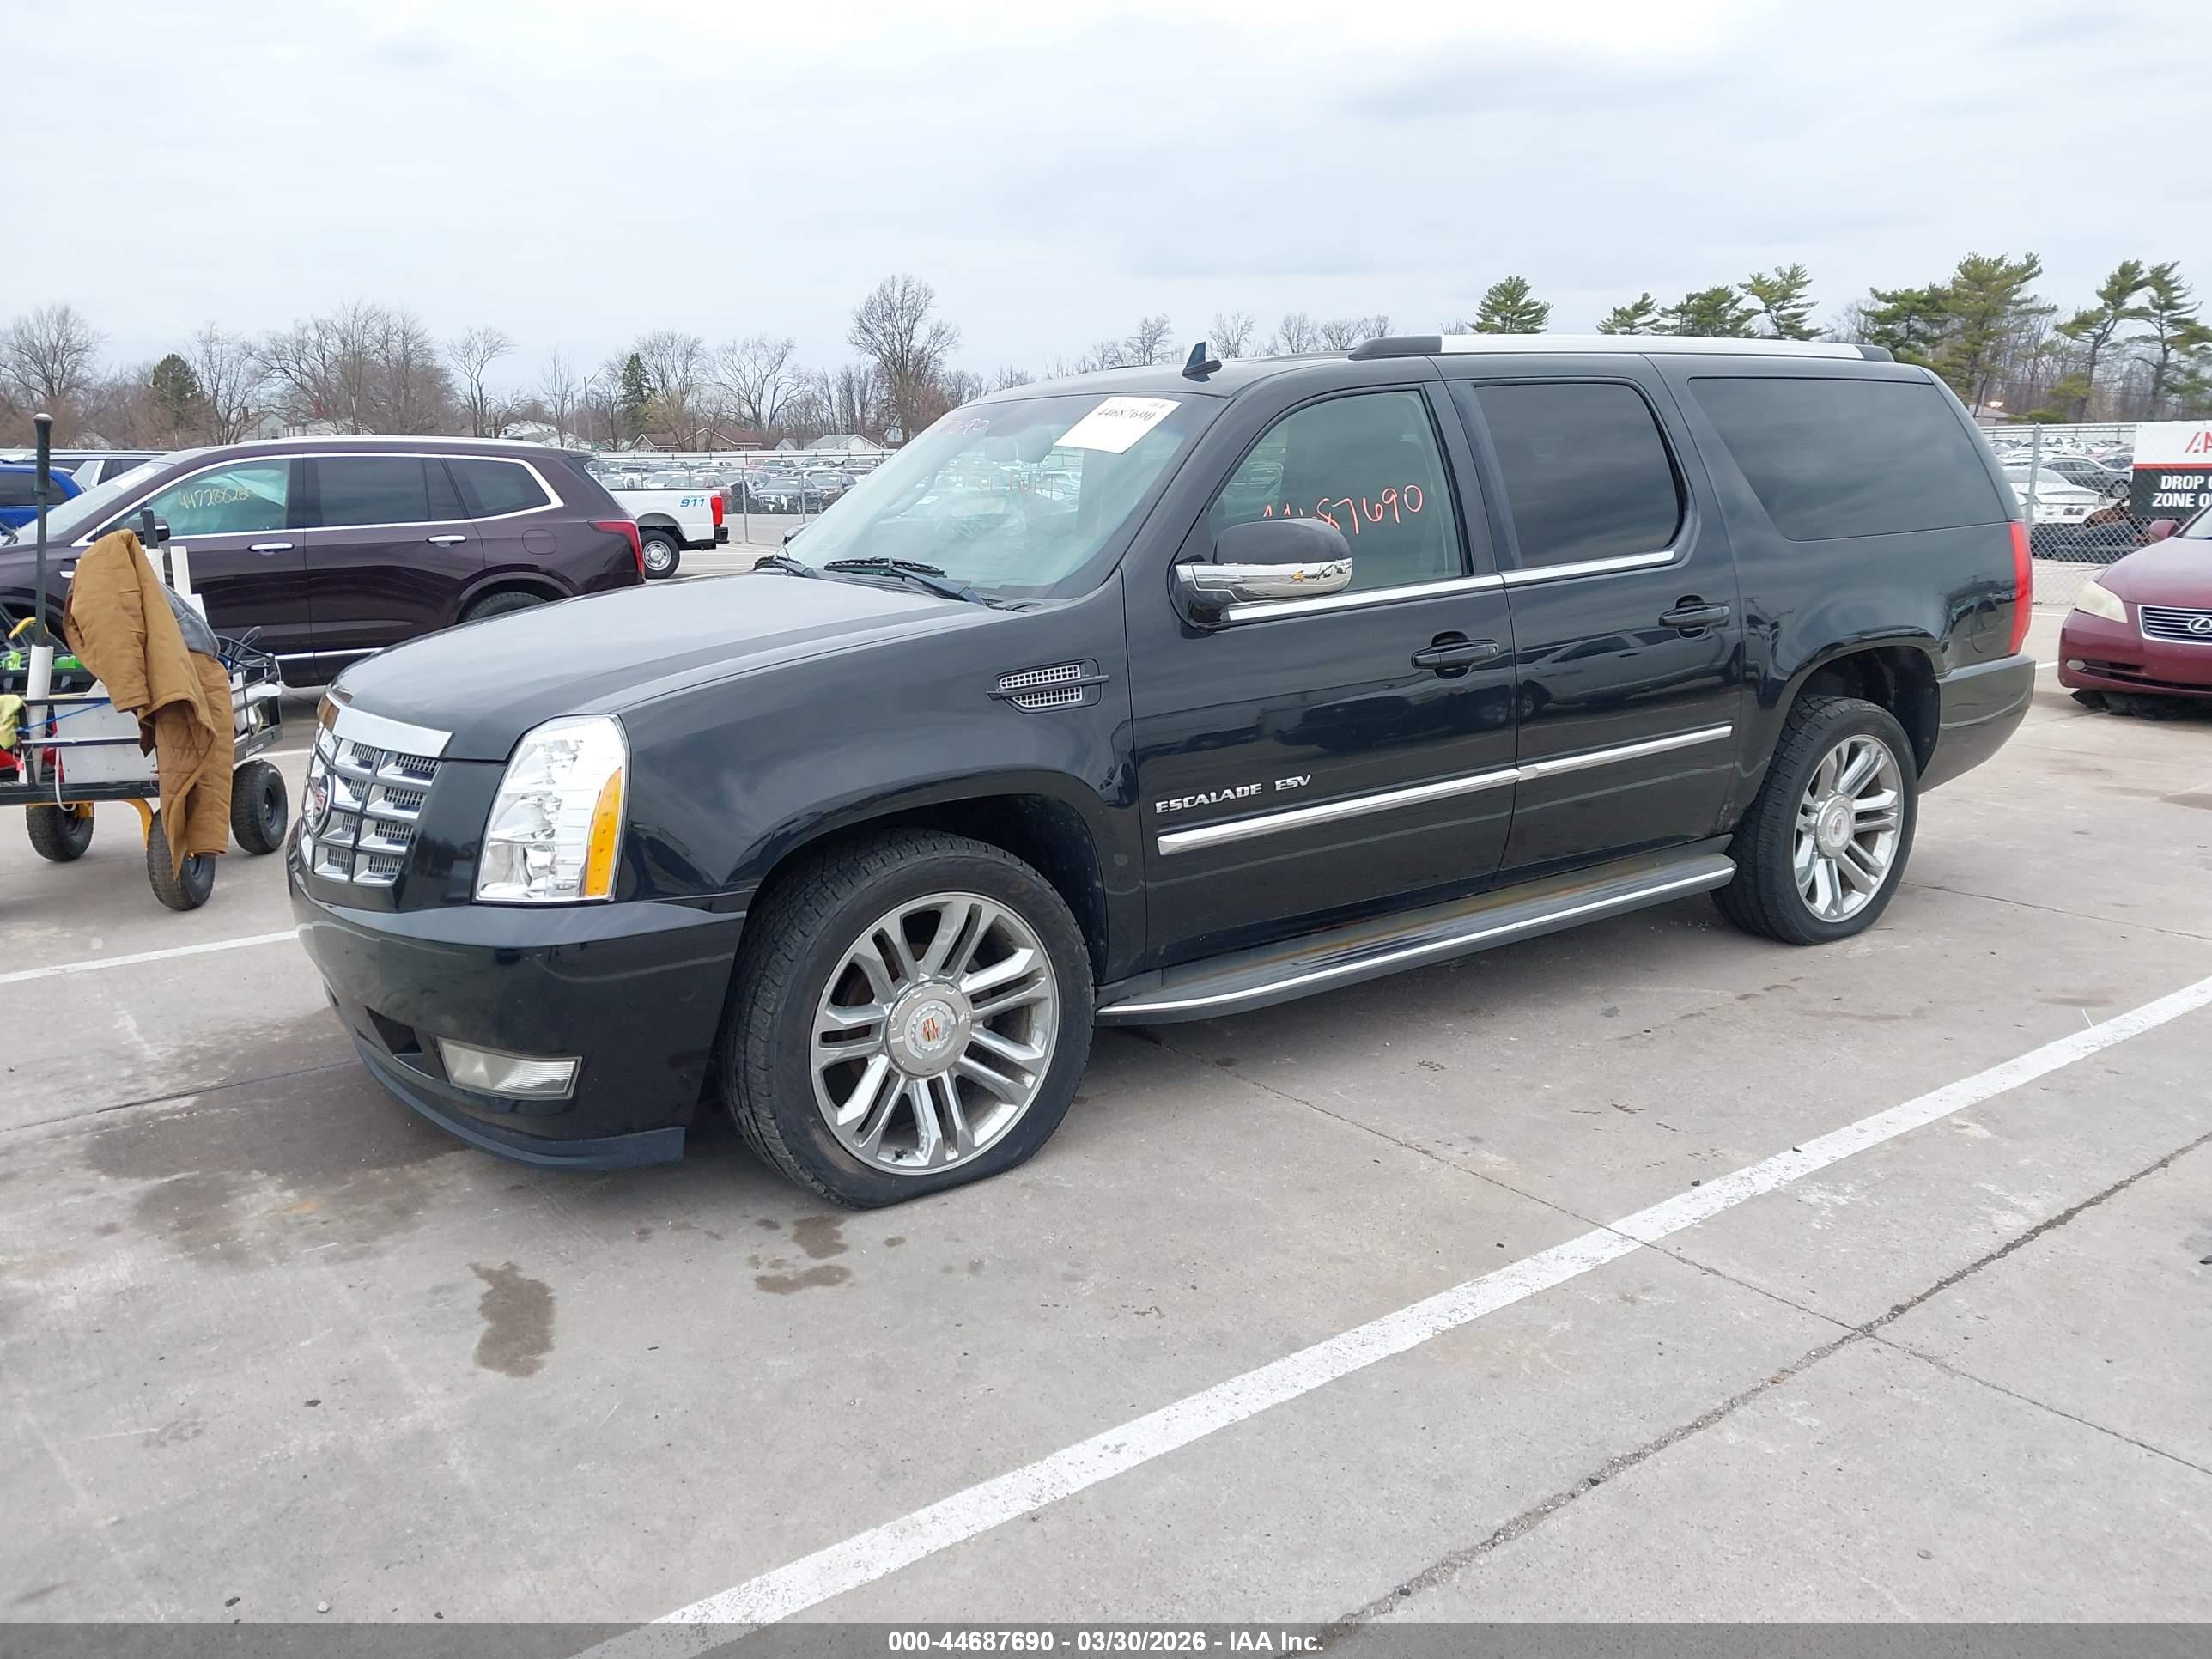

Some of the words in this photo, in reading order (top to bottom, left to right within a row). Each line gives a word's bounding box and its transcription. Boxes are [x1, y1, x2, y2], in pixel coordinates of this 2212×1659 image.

[2160, 475, 2205, 489] DROP
[679, 497, 705, 507] 911
[2152, 492, 2196, 507] ZONE
[2198, 492, 2212, 507] O
[1263, 484, 1424, 535] 87690
[1155, 783, 1262, 814] ESCALADE
[1274, 774, 1312, 791] ESV
